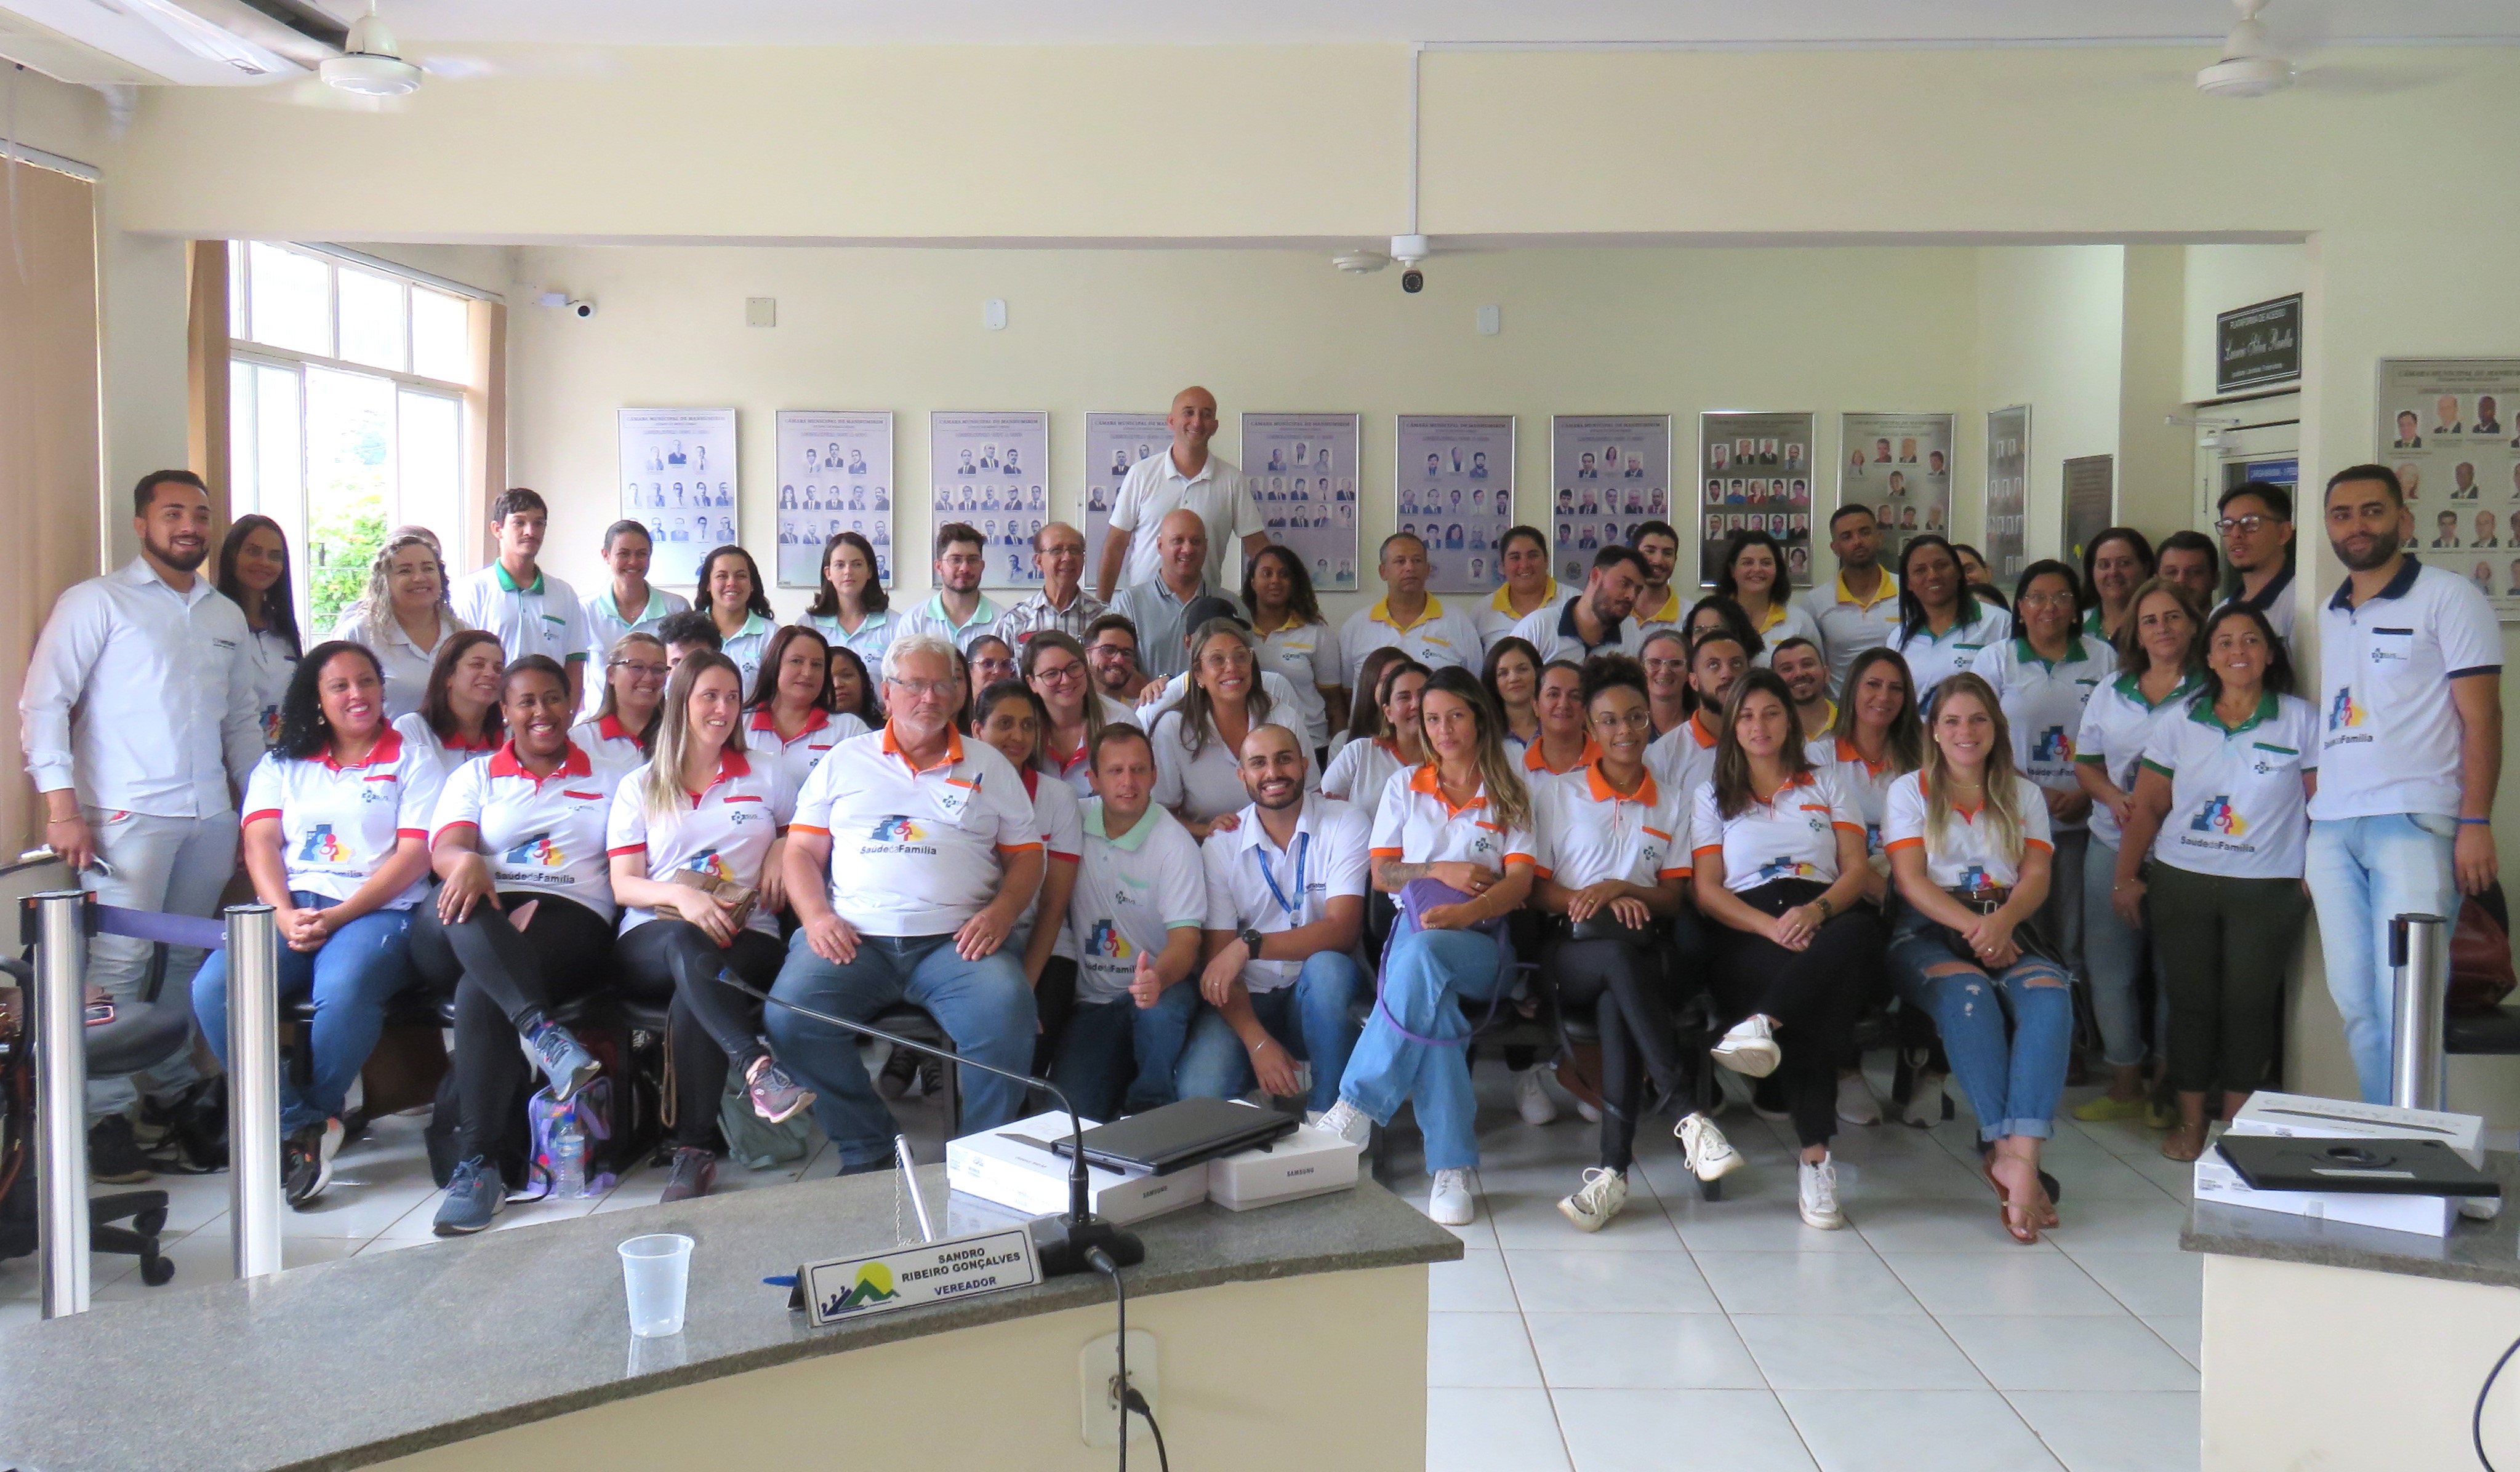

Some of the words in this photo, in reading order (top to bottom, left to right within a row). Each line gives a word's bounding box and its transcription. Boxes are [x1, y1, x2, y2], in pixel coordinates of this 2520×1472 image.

[1286, 1167, 1314, 1177] SAMSUNG
[1142, 1185, 1168, 1198] SAMSUNG
[938, 1247, 985, 1263] SANDRO
[901, 1266, 949, 1283] RIBEIRO
[952, 1252, 1021, 1273] GONÇALVES
[934, 1276, 997, 1296] VEREADOR
